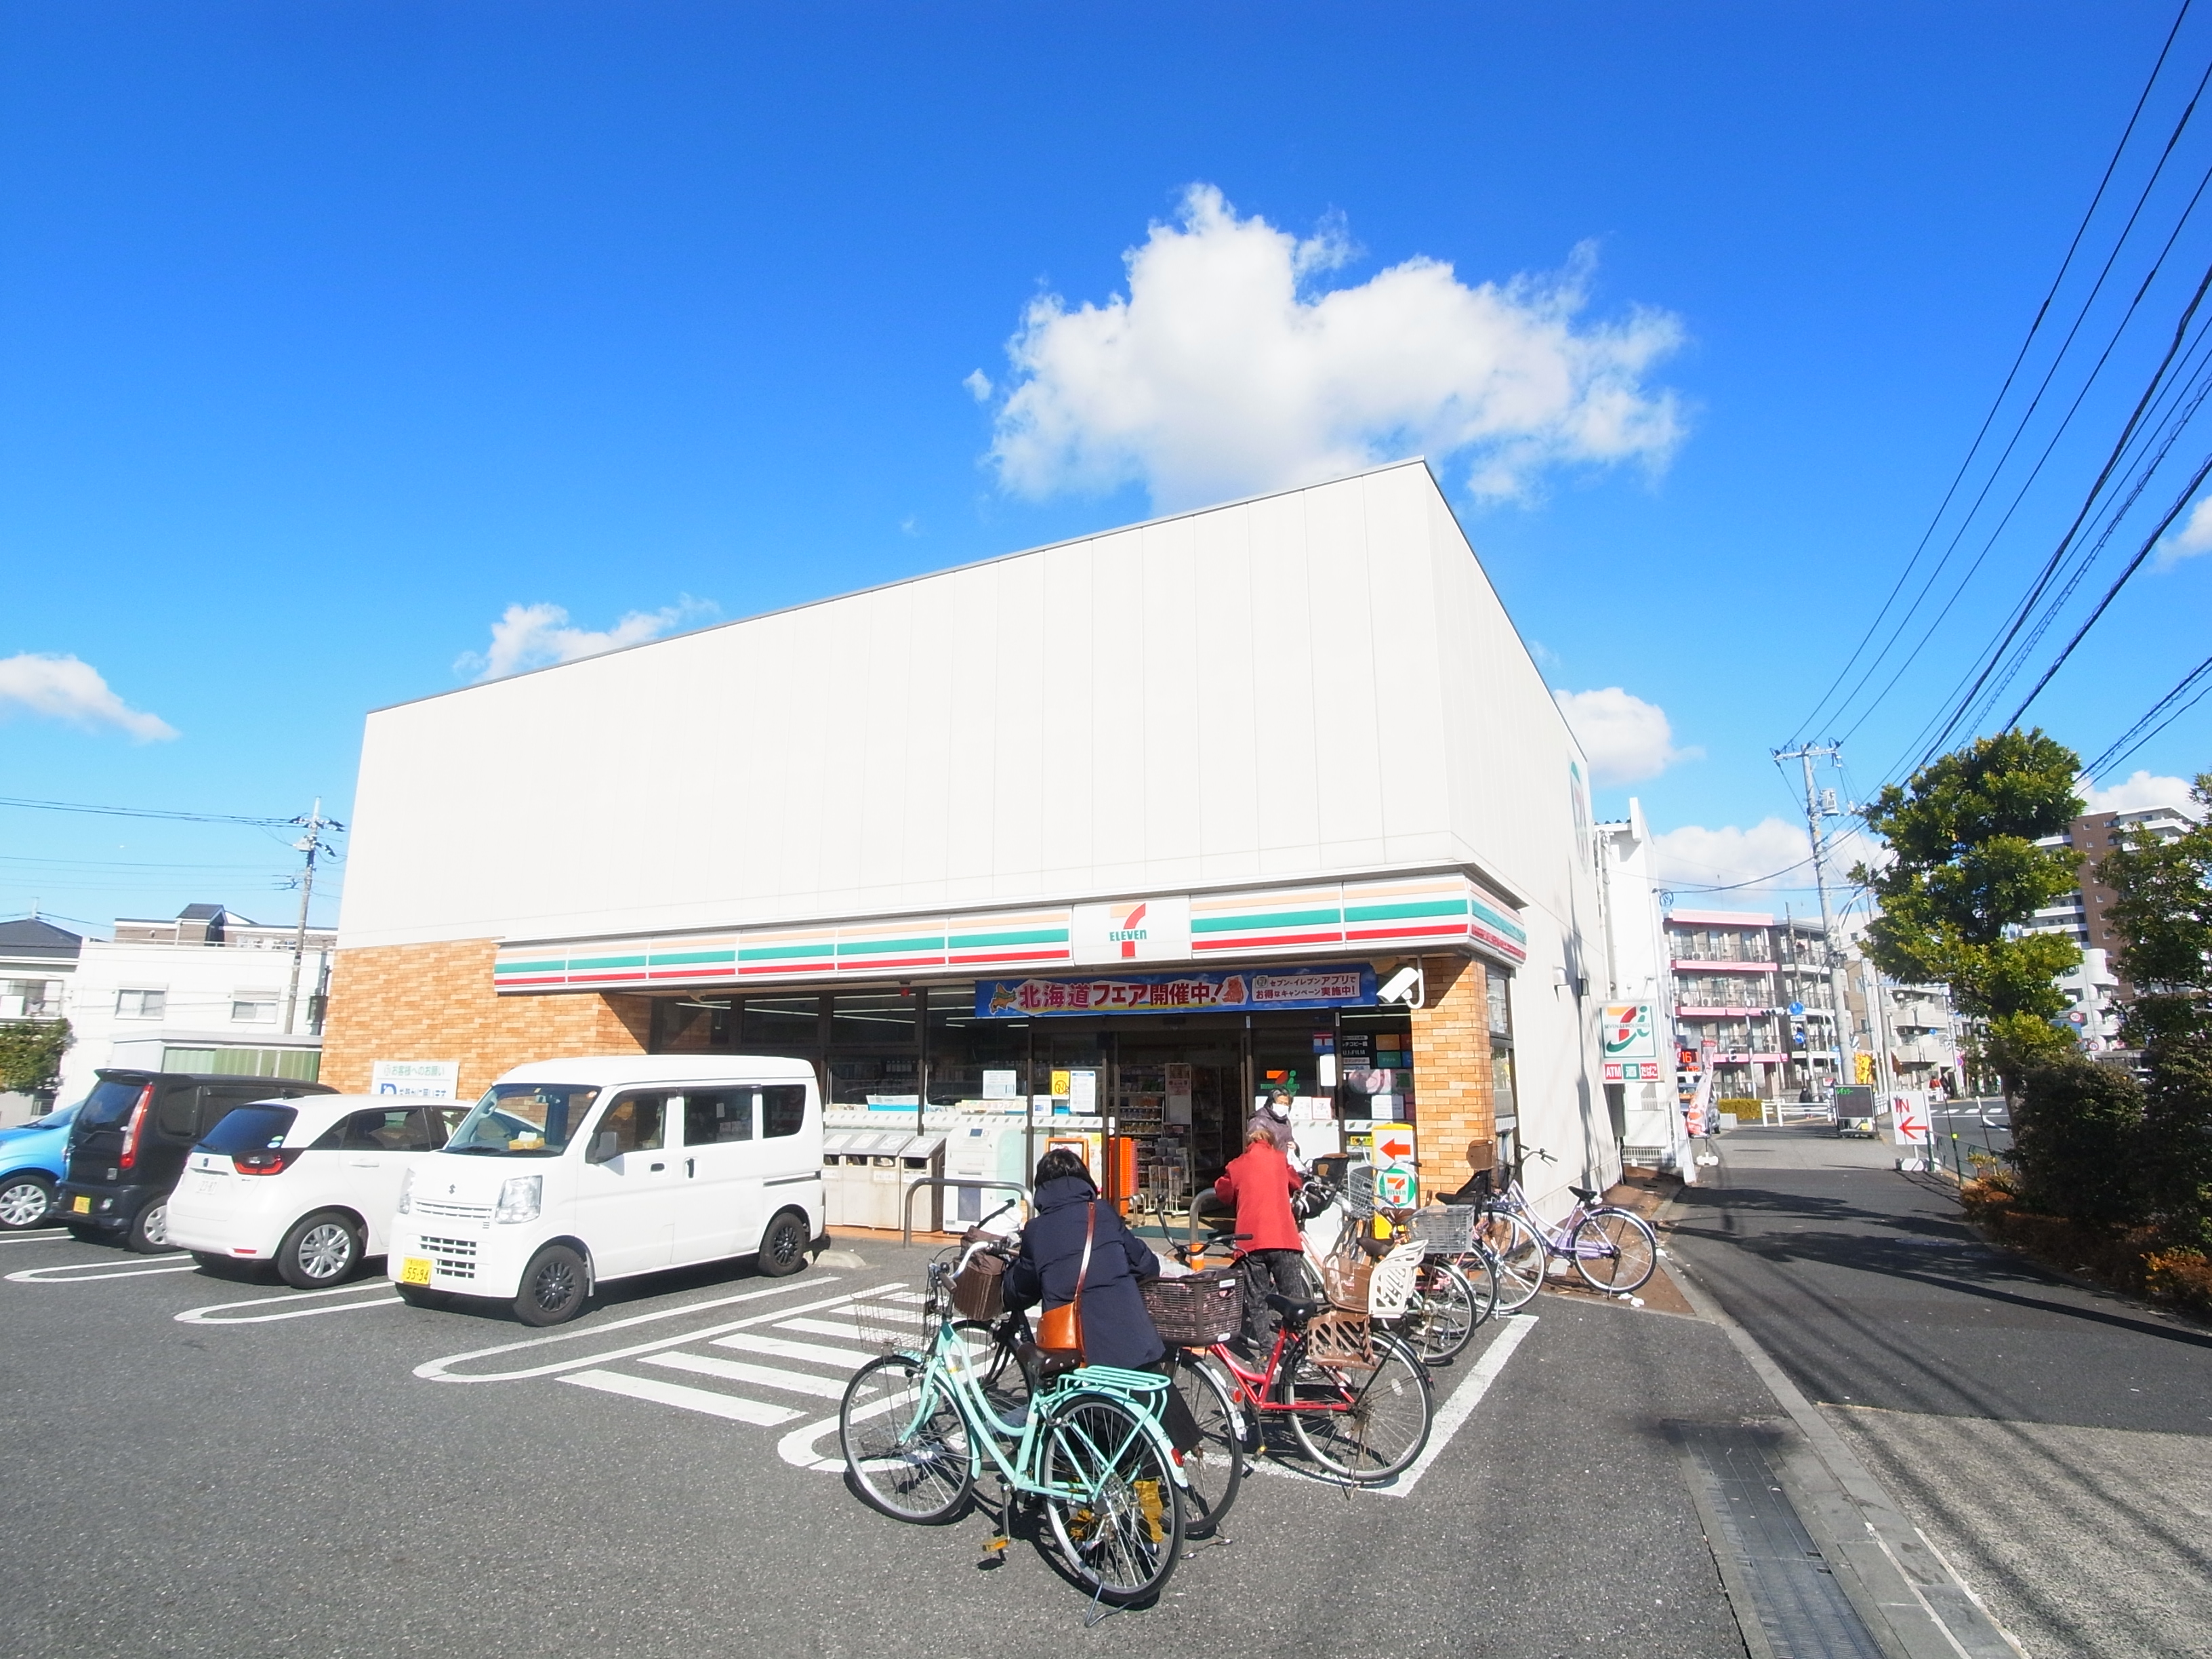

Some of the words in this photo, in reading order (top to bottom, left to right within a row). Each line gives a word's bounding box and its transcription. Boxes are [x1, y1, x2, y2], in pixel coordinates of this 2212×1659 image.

[1019, 982, 1224, 1009] 北海道フェア開催中!
[1606, 1066, 1622, 1078] ATM
[1626, 1066, 1637, 1078] 酒
[1641, 1066, 1658, 1077] たばこ
[1894, 1098, 1910, 1113] IN
